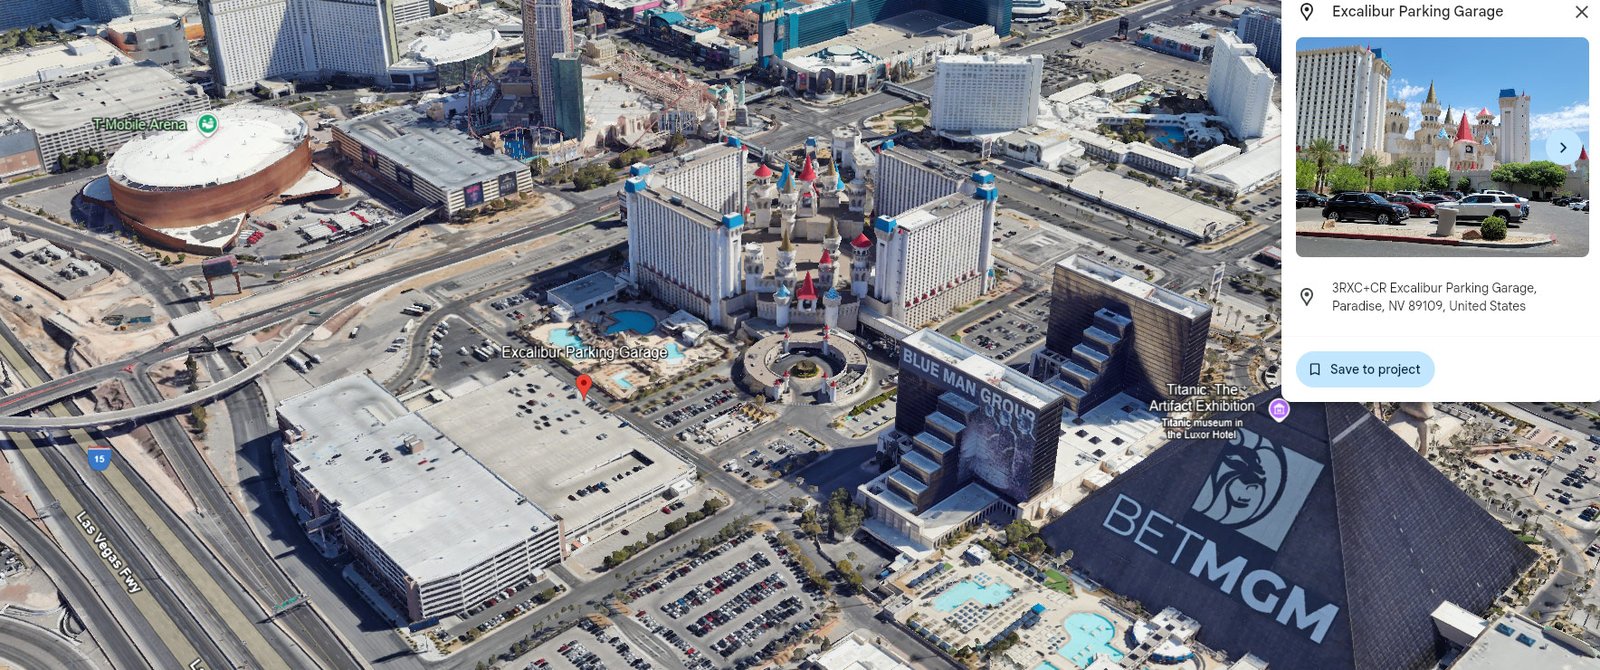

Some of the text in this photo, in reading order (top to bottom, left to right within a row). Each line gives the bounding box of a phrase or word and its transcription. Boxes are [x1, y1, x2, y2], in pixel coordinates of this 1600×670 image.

[762, 8, 785, 23] MGM
[902, 347, 1037, 421] BLUE MAN GROUP
[1103, 493, 1340, 645] BETMGM
